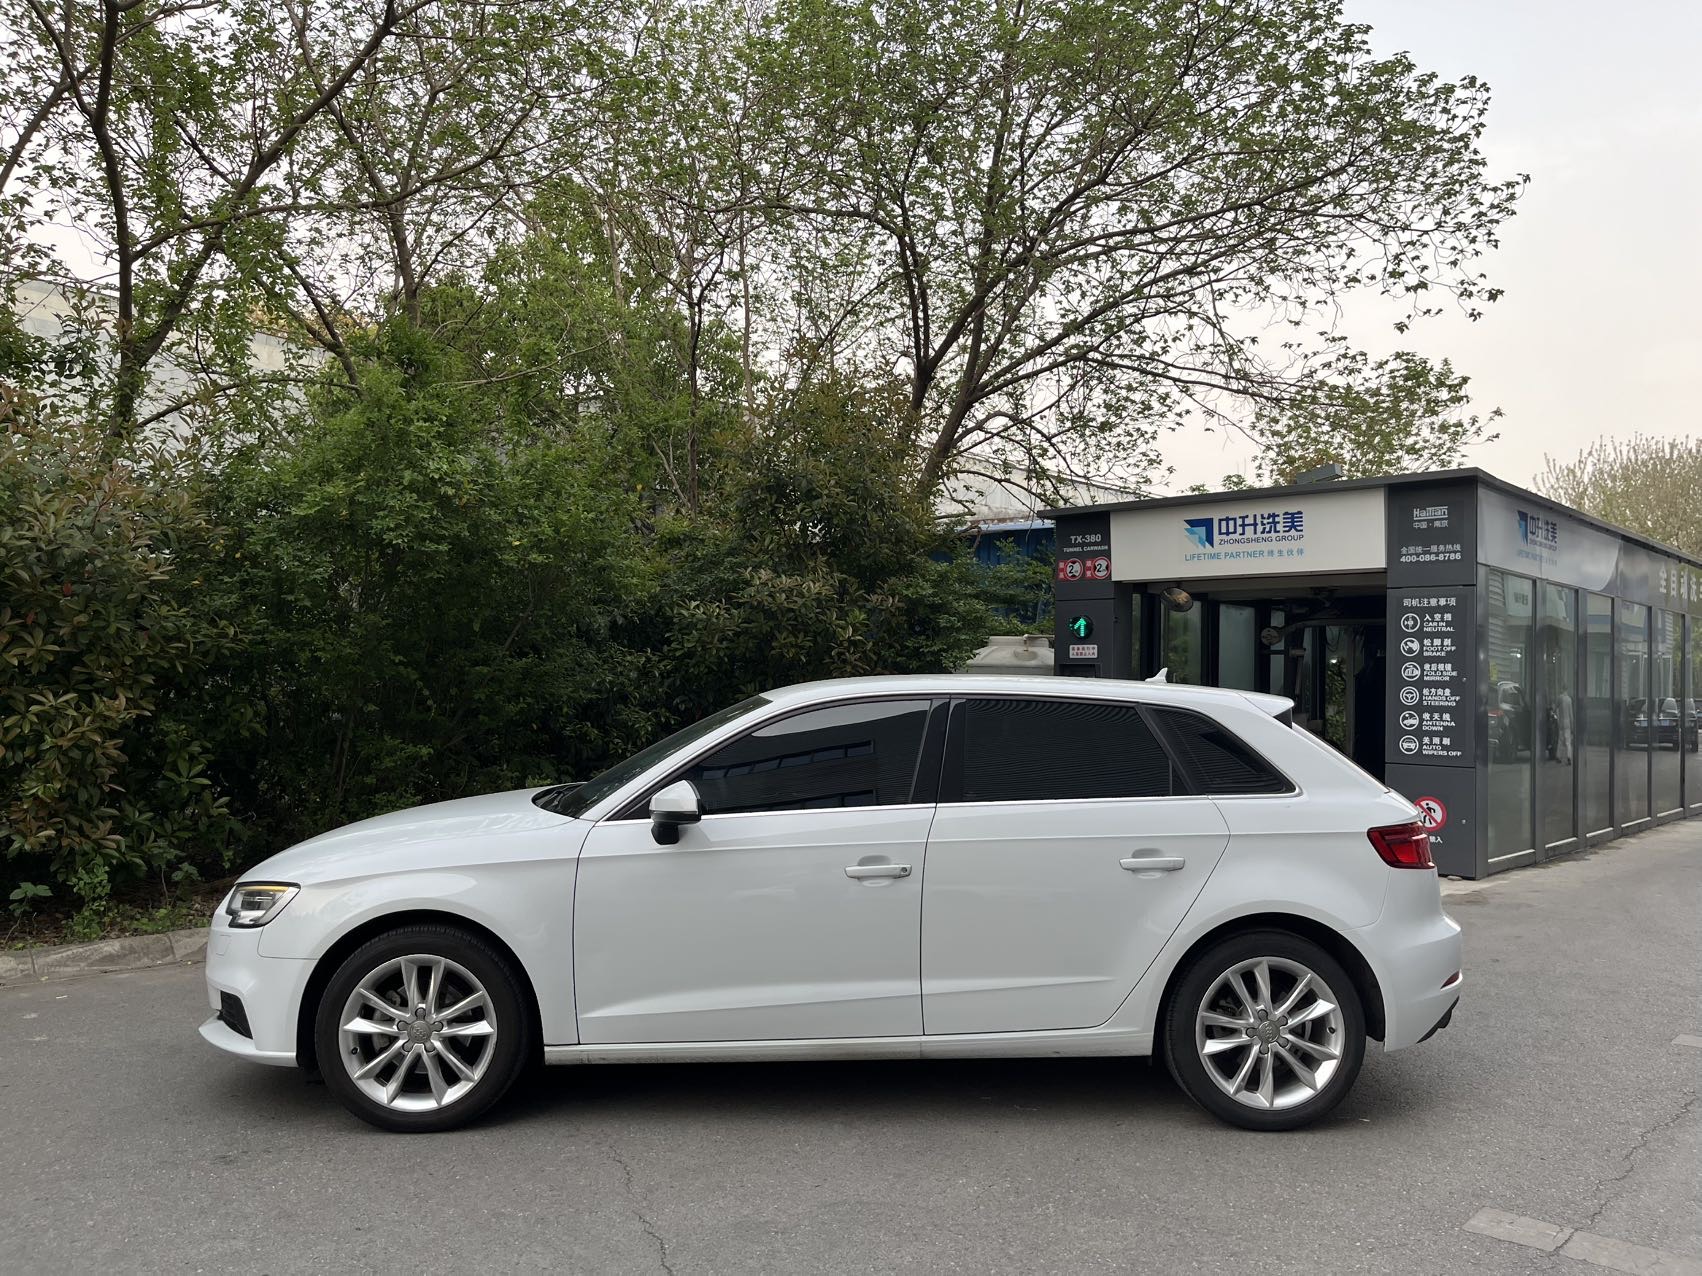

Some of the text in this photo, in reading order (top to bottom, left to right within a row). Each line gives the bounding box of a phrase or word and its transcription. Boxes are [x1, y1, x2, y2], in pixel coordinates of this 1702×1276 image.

[1218, 511, 1304, 536] 中升洗美
[1070, 534, 1102, 543] TX-380
[1219, 534, 1304, 545] ZHONGSHENG GROUP
[1400, 544, 1461, 554] 全国统一服务热线
[1184, 549, 1265, 561] LIFETIME PARTNER
[1402, 597, 1456, 607] 司机注意事项
